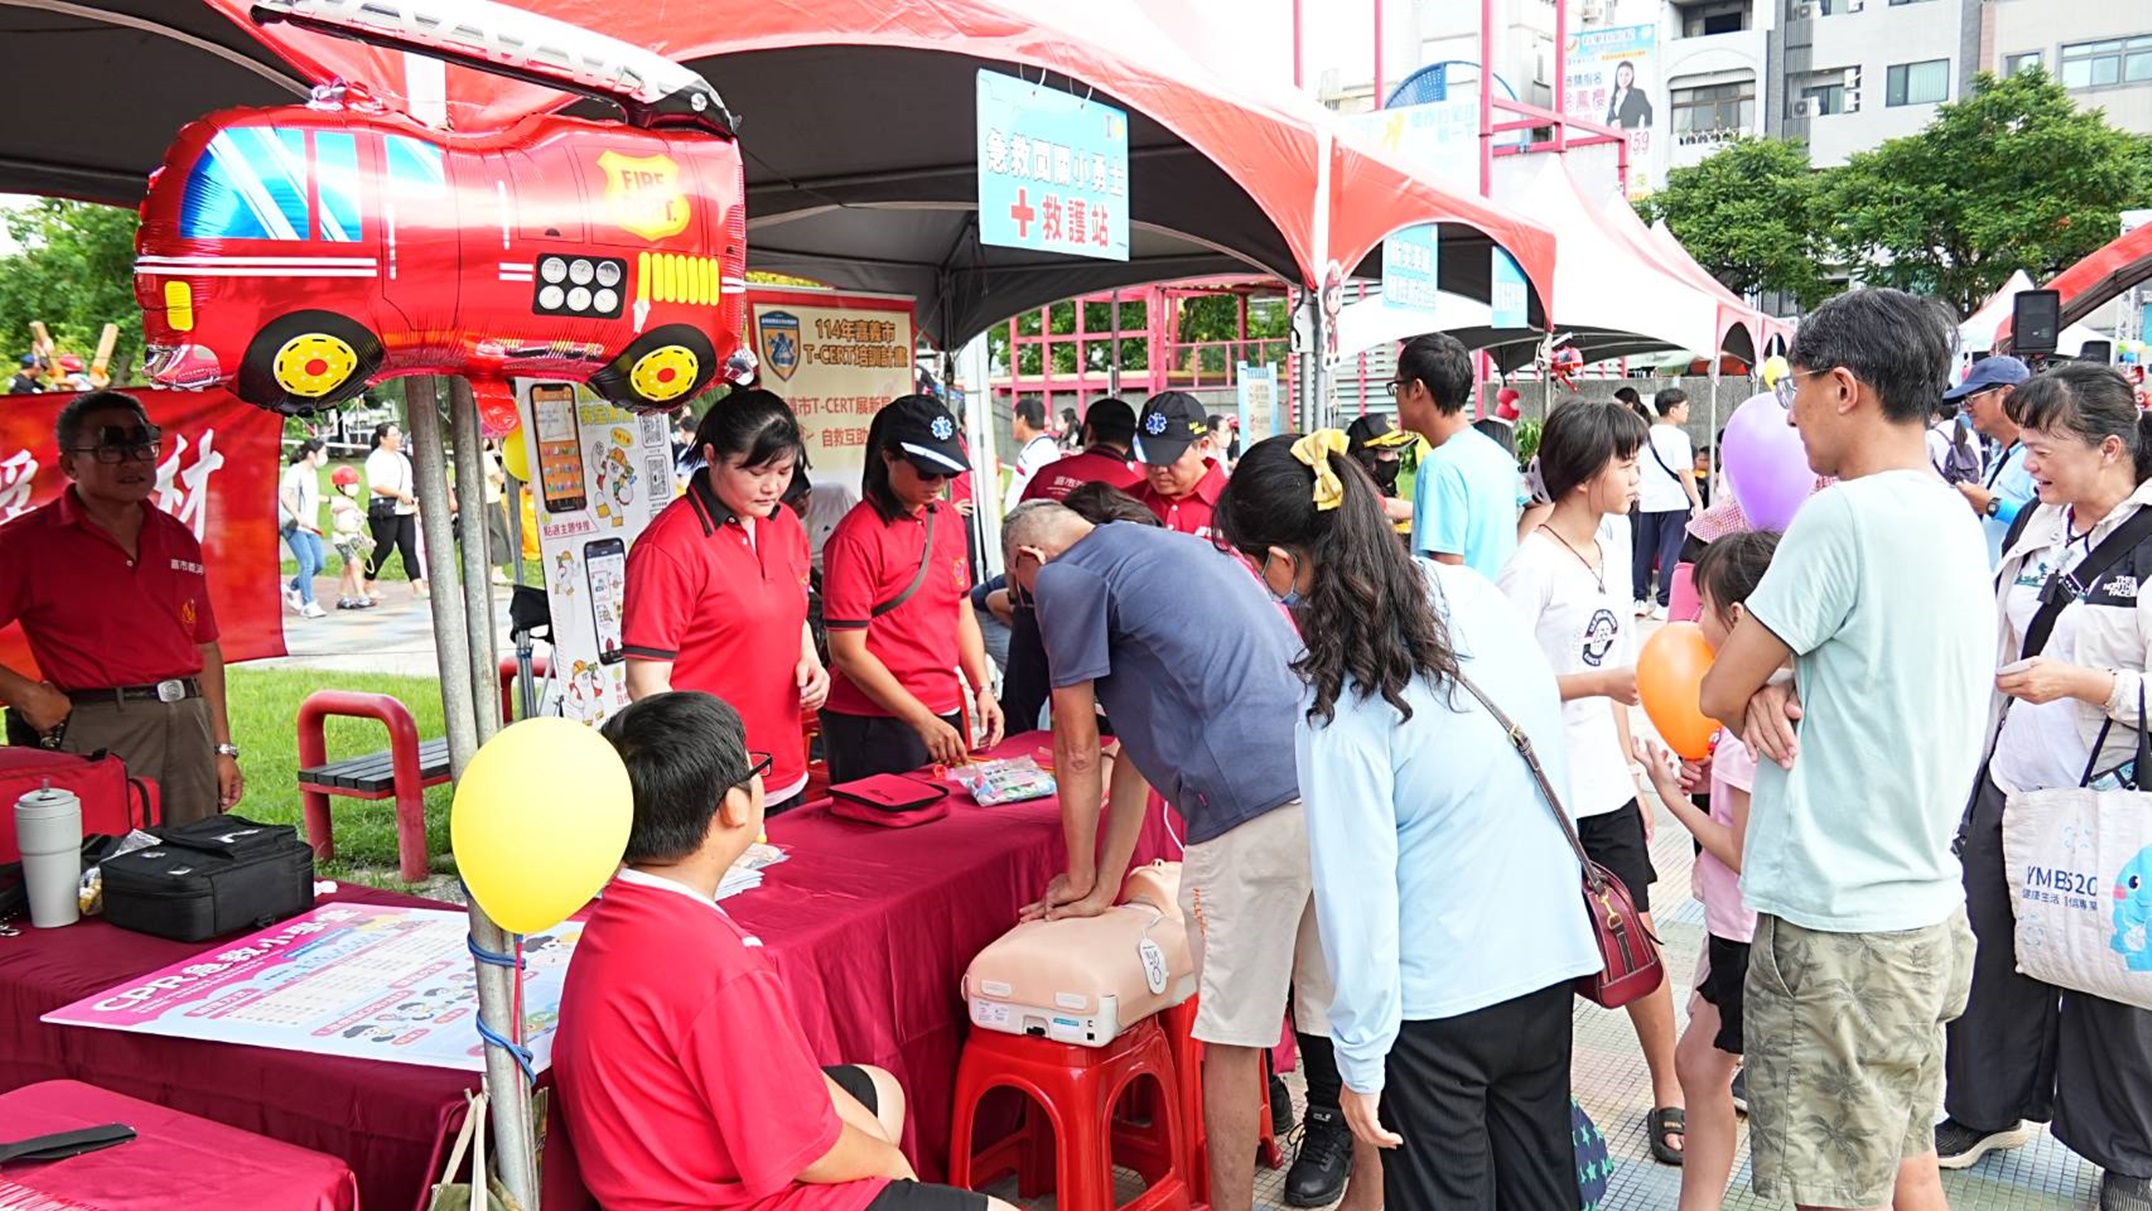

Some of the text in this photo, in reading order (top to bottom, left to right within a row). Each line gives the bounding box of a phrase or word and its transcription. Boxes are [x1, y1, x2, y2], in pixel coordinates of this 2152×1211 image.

[1042, 195, 1108, 247] 救護站
[815, 318, 895, 343] 114年嘉義市
[803, 344, 908, 367] T-CERT培訓計畫
